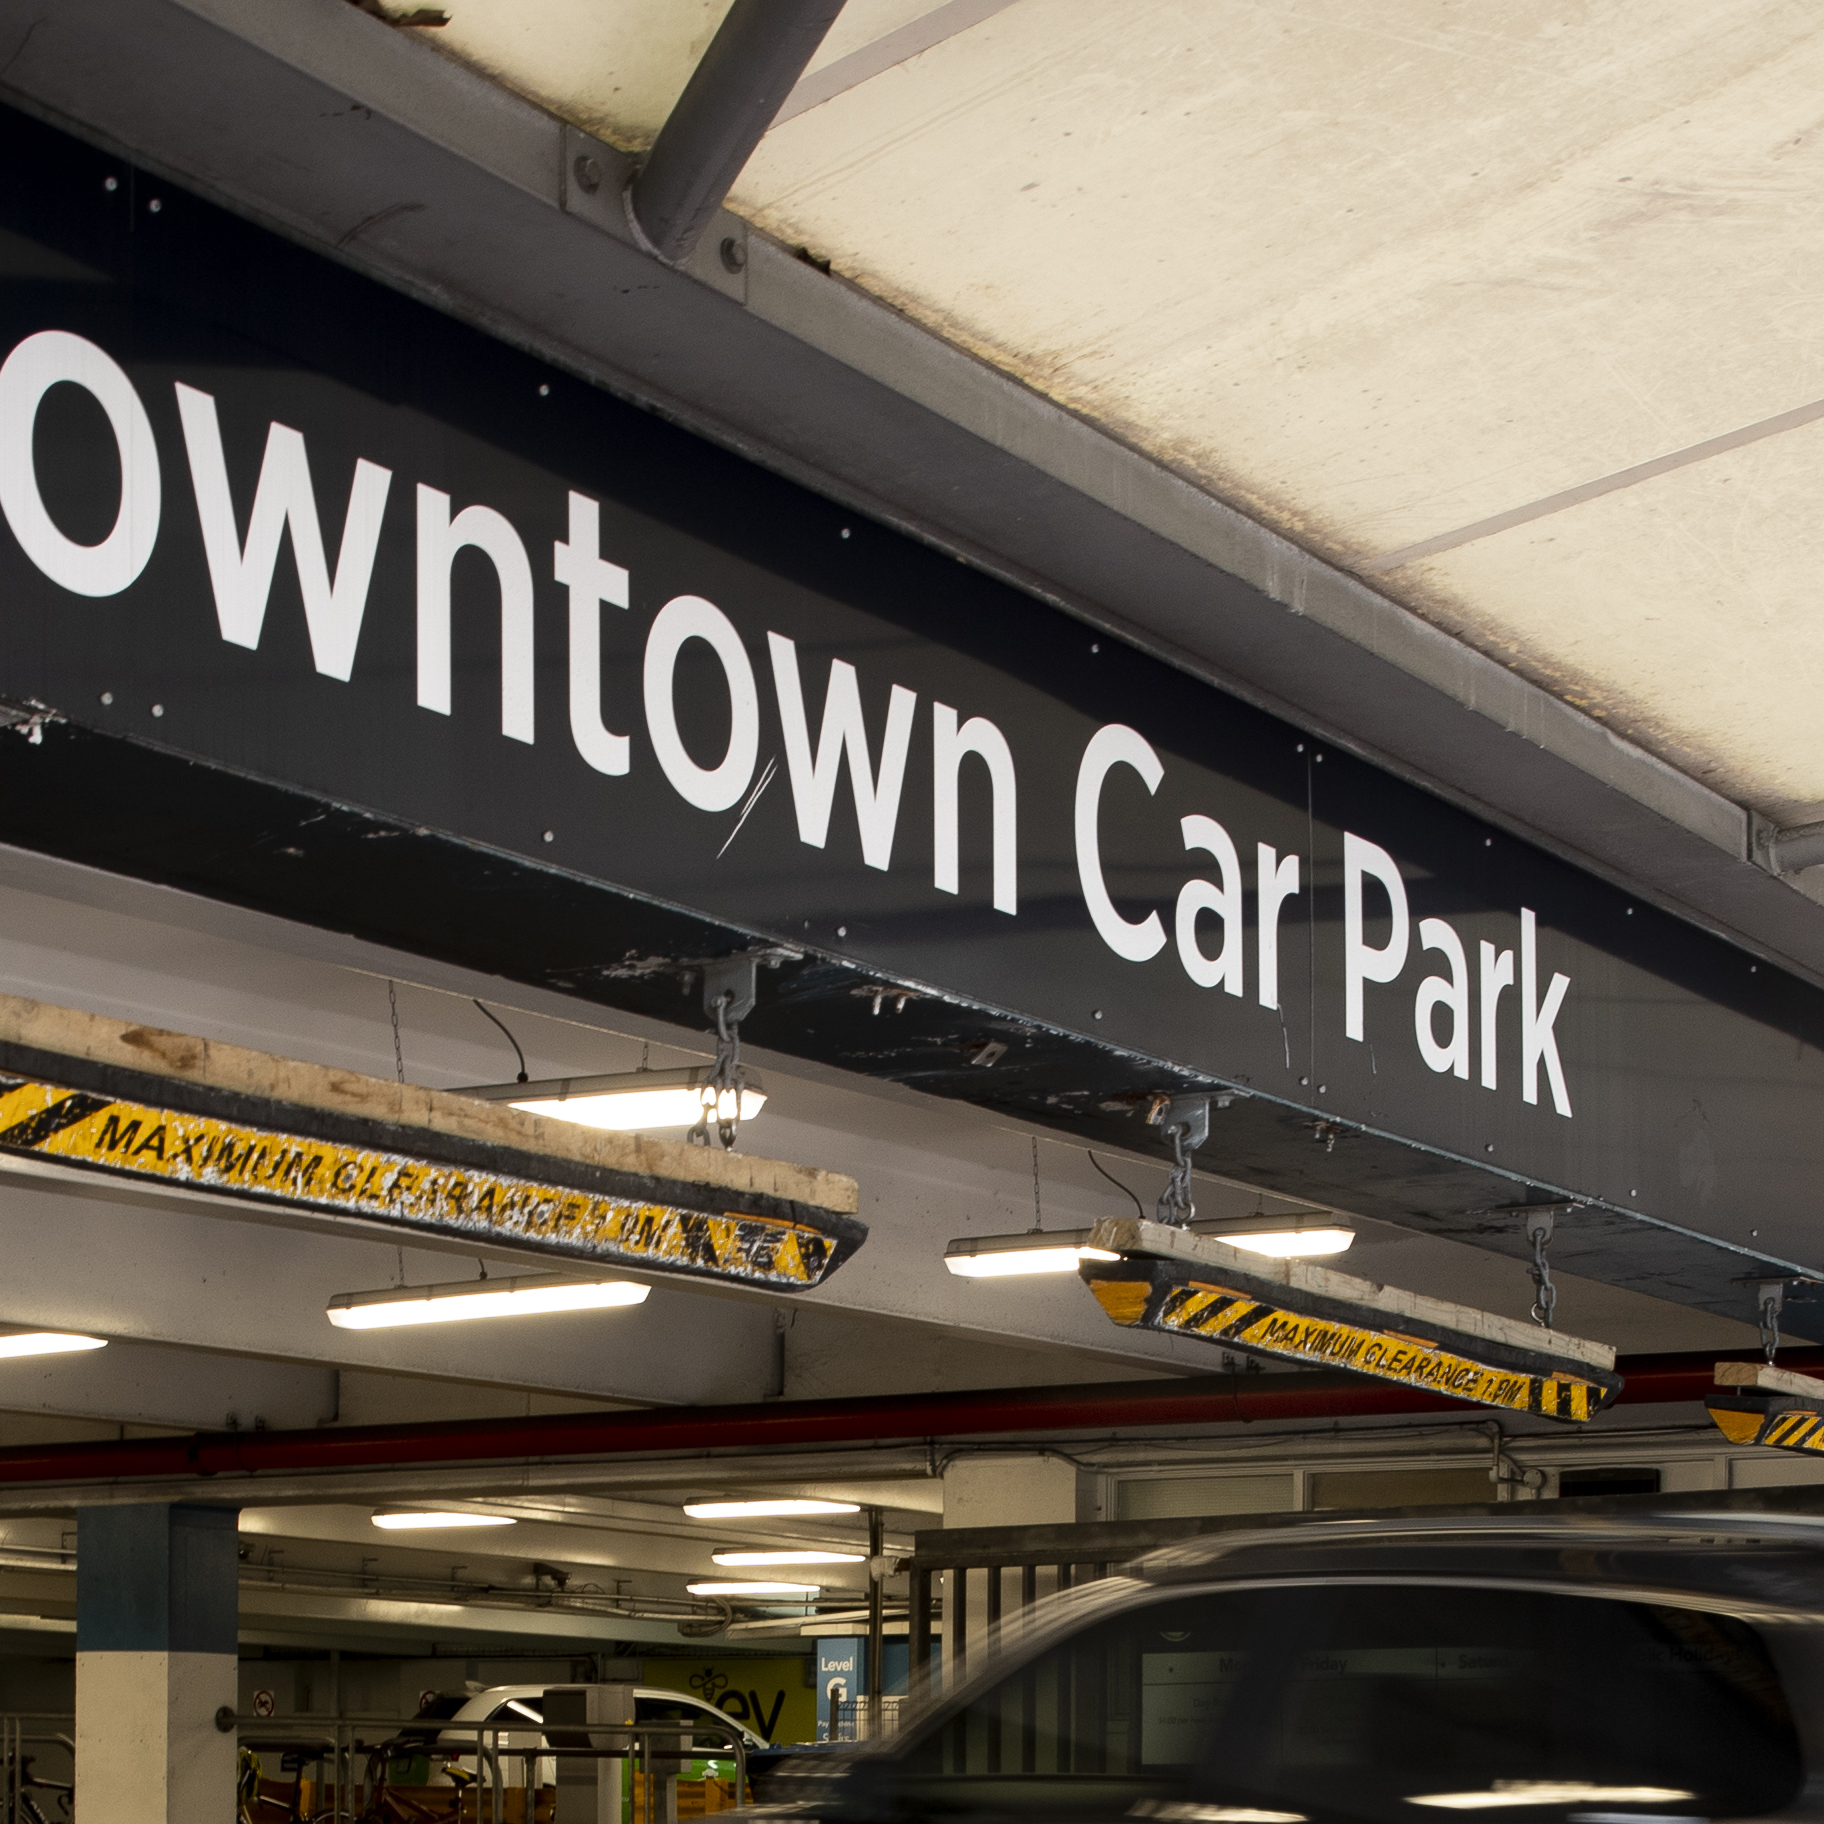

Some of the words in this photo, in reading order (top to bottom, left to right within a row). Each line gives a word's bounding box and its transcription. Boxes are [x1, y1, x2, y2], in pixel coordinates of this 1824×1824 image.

[1075, 724, 1300, 1012] Car
[1344, 831, 1573, 1118] Park
[1260, 1317, 1365, 1360] MAXIMUM
[1363, 1342, 1484, 1393] CLEARANCE
[820, 1656, 854, 1672] Level
